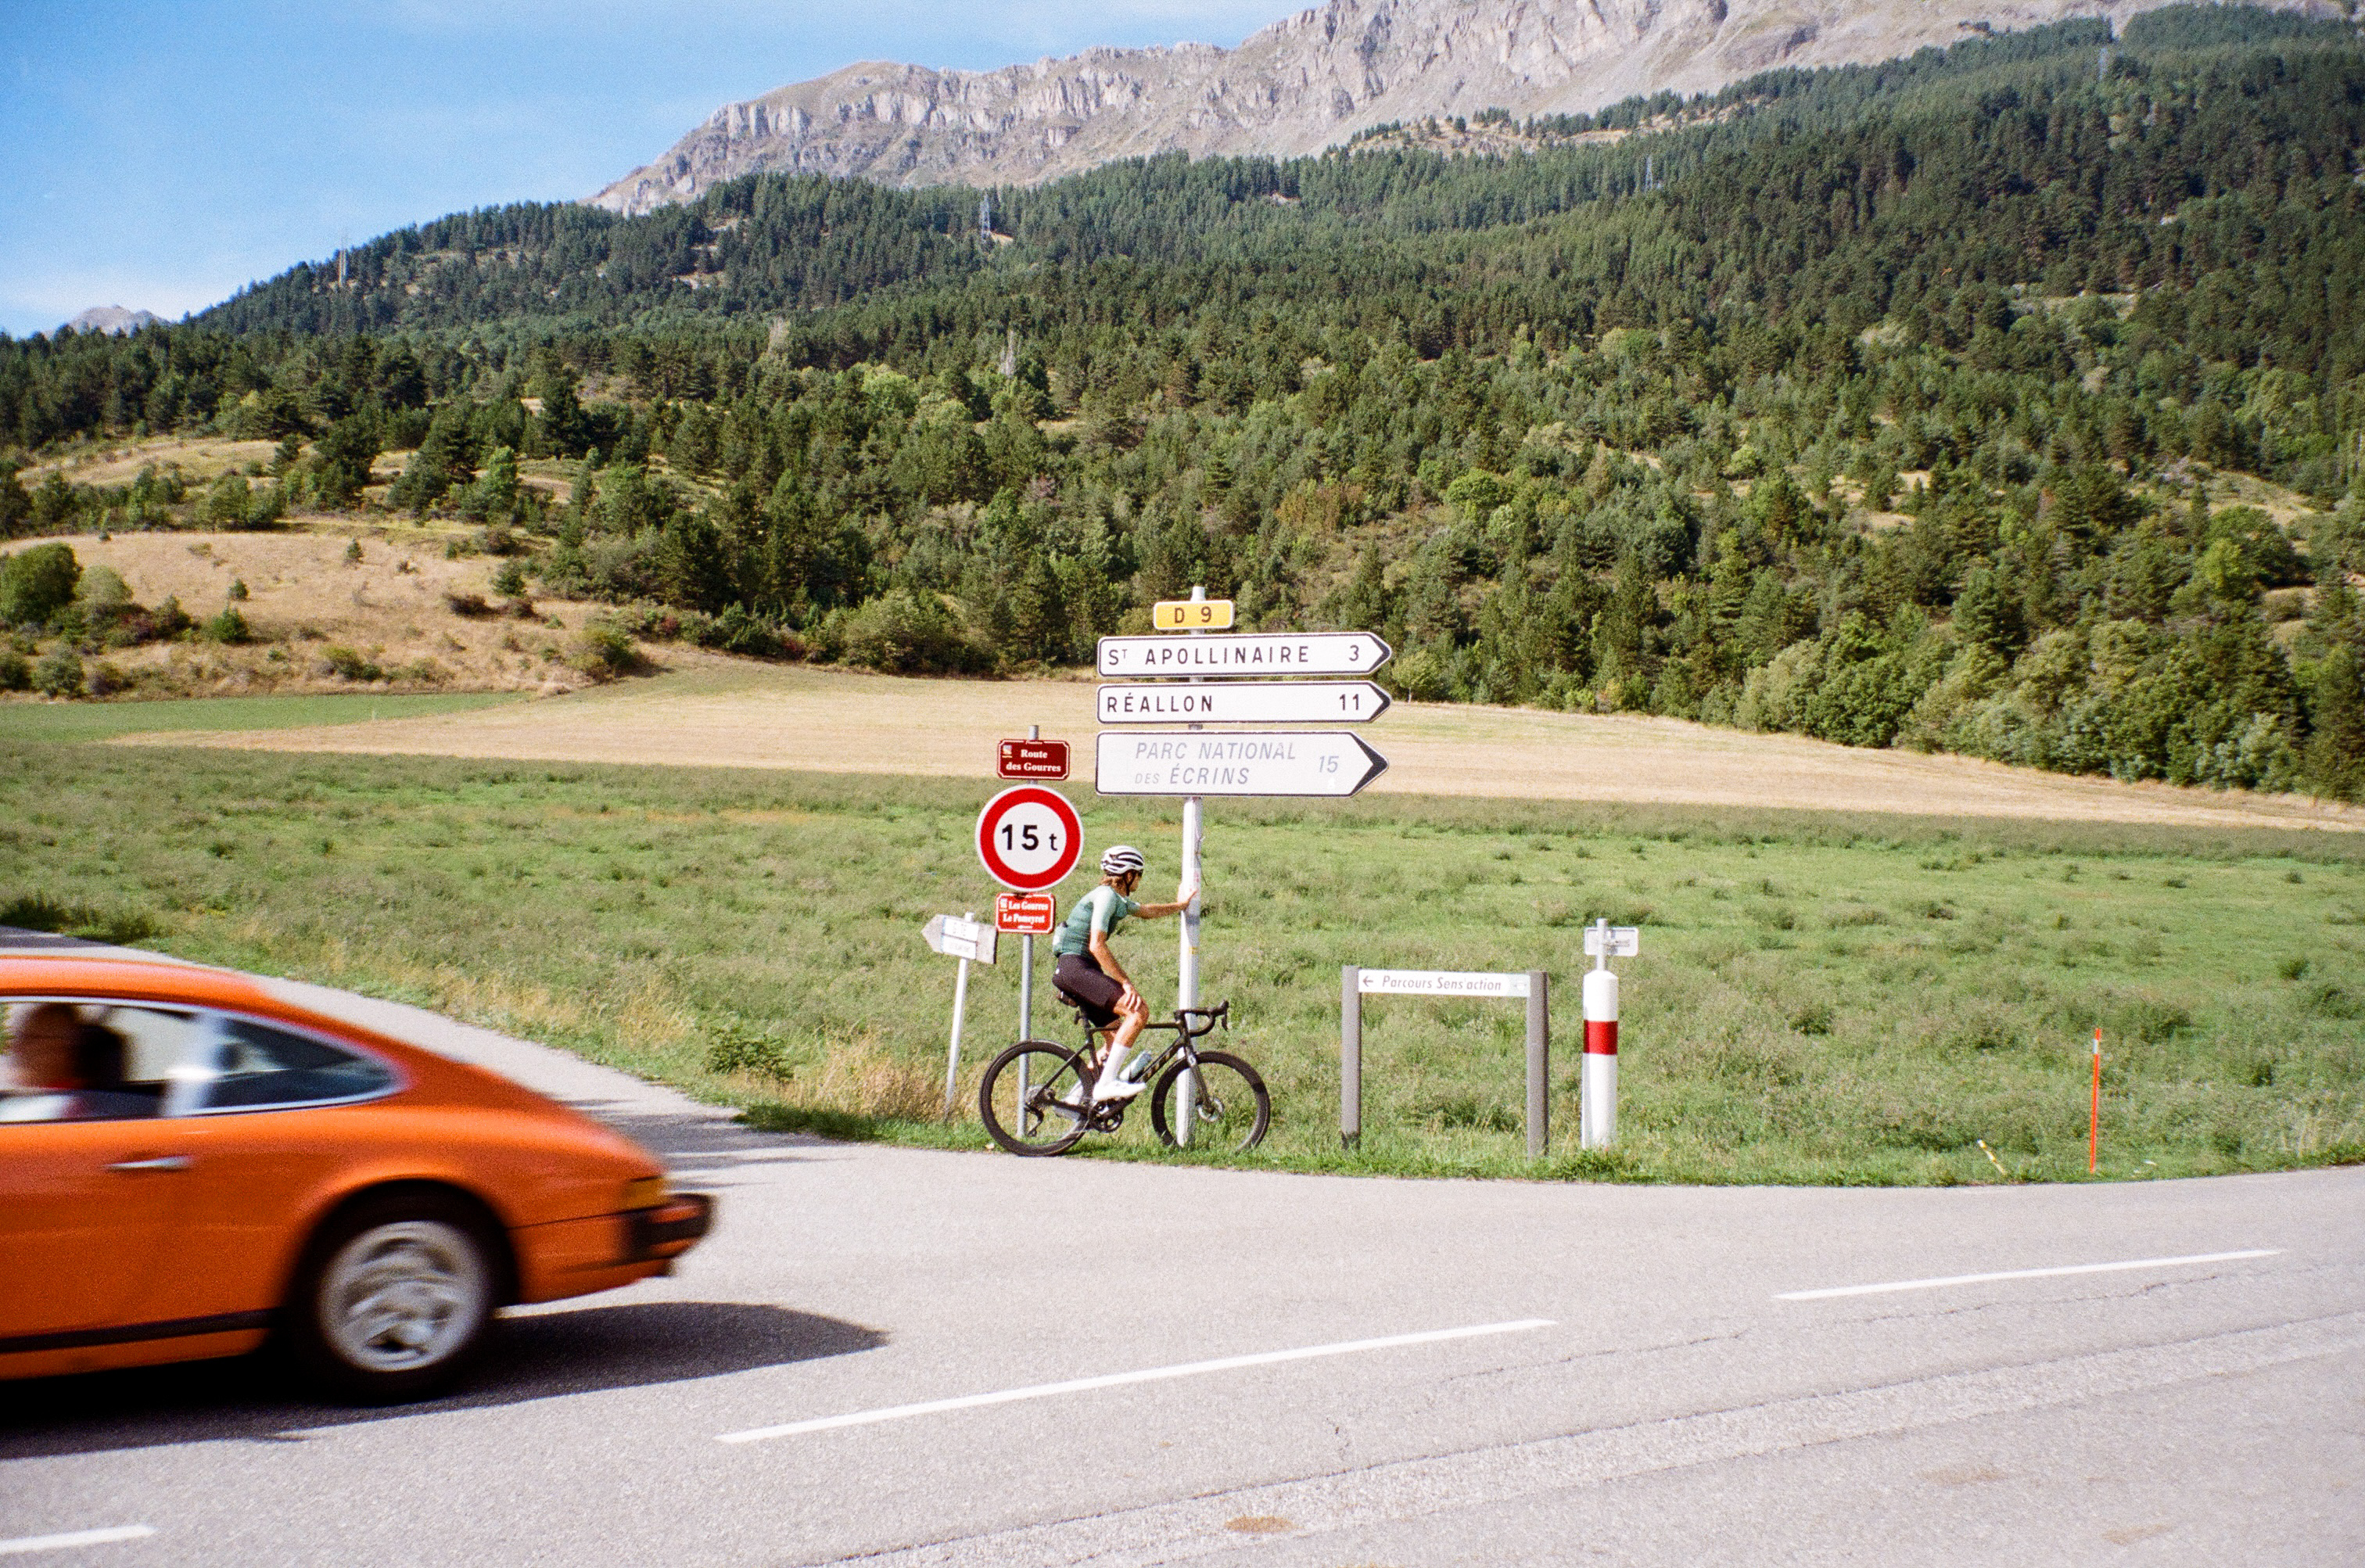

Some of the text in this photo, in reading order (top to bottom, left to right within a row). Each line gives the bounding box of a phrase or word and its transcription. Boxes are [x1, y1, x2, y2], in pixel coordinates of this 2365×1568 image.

[1174, 606, 1212, 623] D 9
[1145, 645, 1309, 665] APOLLINAIRE
[1349, 644, 1359, 662] 3
[1107, 692, 1360, 712] RÉALLON 11
[1021, 748, 1048, 759] Route
[1136, 741, 1296, 759] PARC NATIONAL
[1006, 762, 1061, 772] des Gourres
[1319, 755, 1340, 773] 15
[1135, 763, 1250, 784] DES ÉCRINS
[1002, 823, 1058, 851] 15 t
[1382, 975, 1432, 989] Parcours
